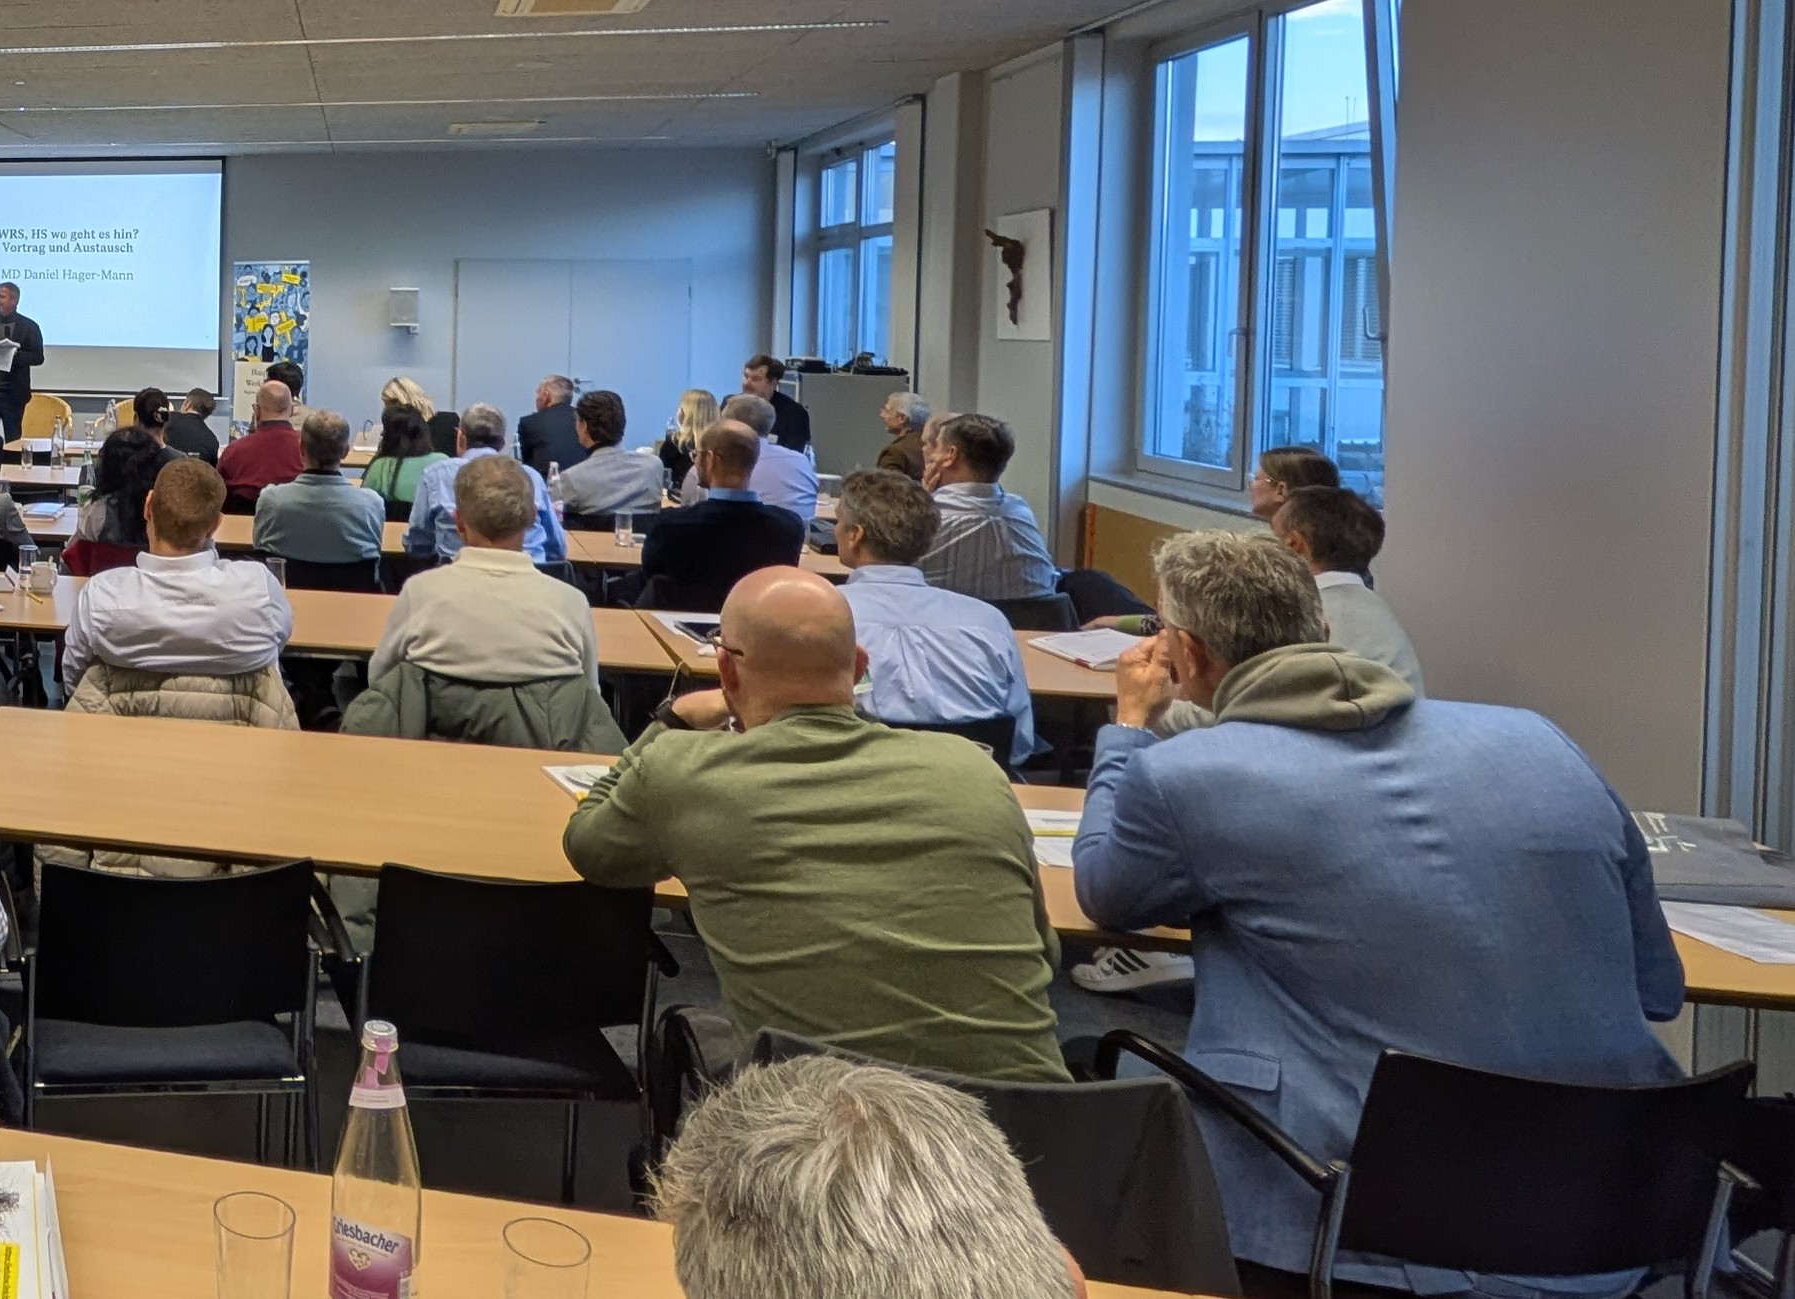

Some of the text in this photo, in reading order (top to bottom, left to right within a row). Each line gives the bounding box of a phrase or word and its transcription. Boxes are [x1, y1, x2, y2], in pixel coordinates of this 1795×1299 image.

[31, 229, 48, 240] HS
[51, 231, 67, 240] wo
[70, 229, 96, 242] geht
[98, 231, 111, 240] es
[113, 228, 140, 240] hin?
[1, 242, 134, 255] Vortrag und Austausch
[1, 269, 134, 283] MD Daniel Hager-Mann
[332, 1215, 400, 1254] Griesbacher
